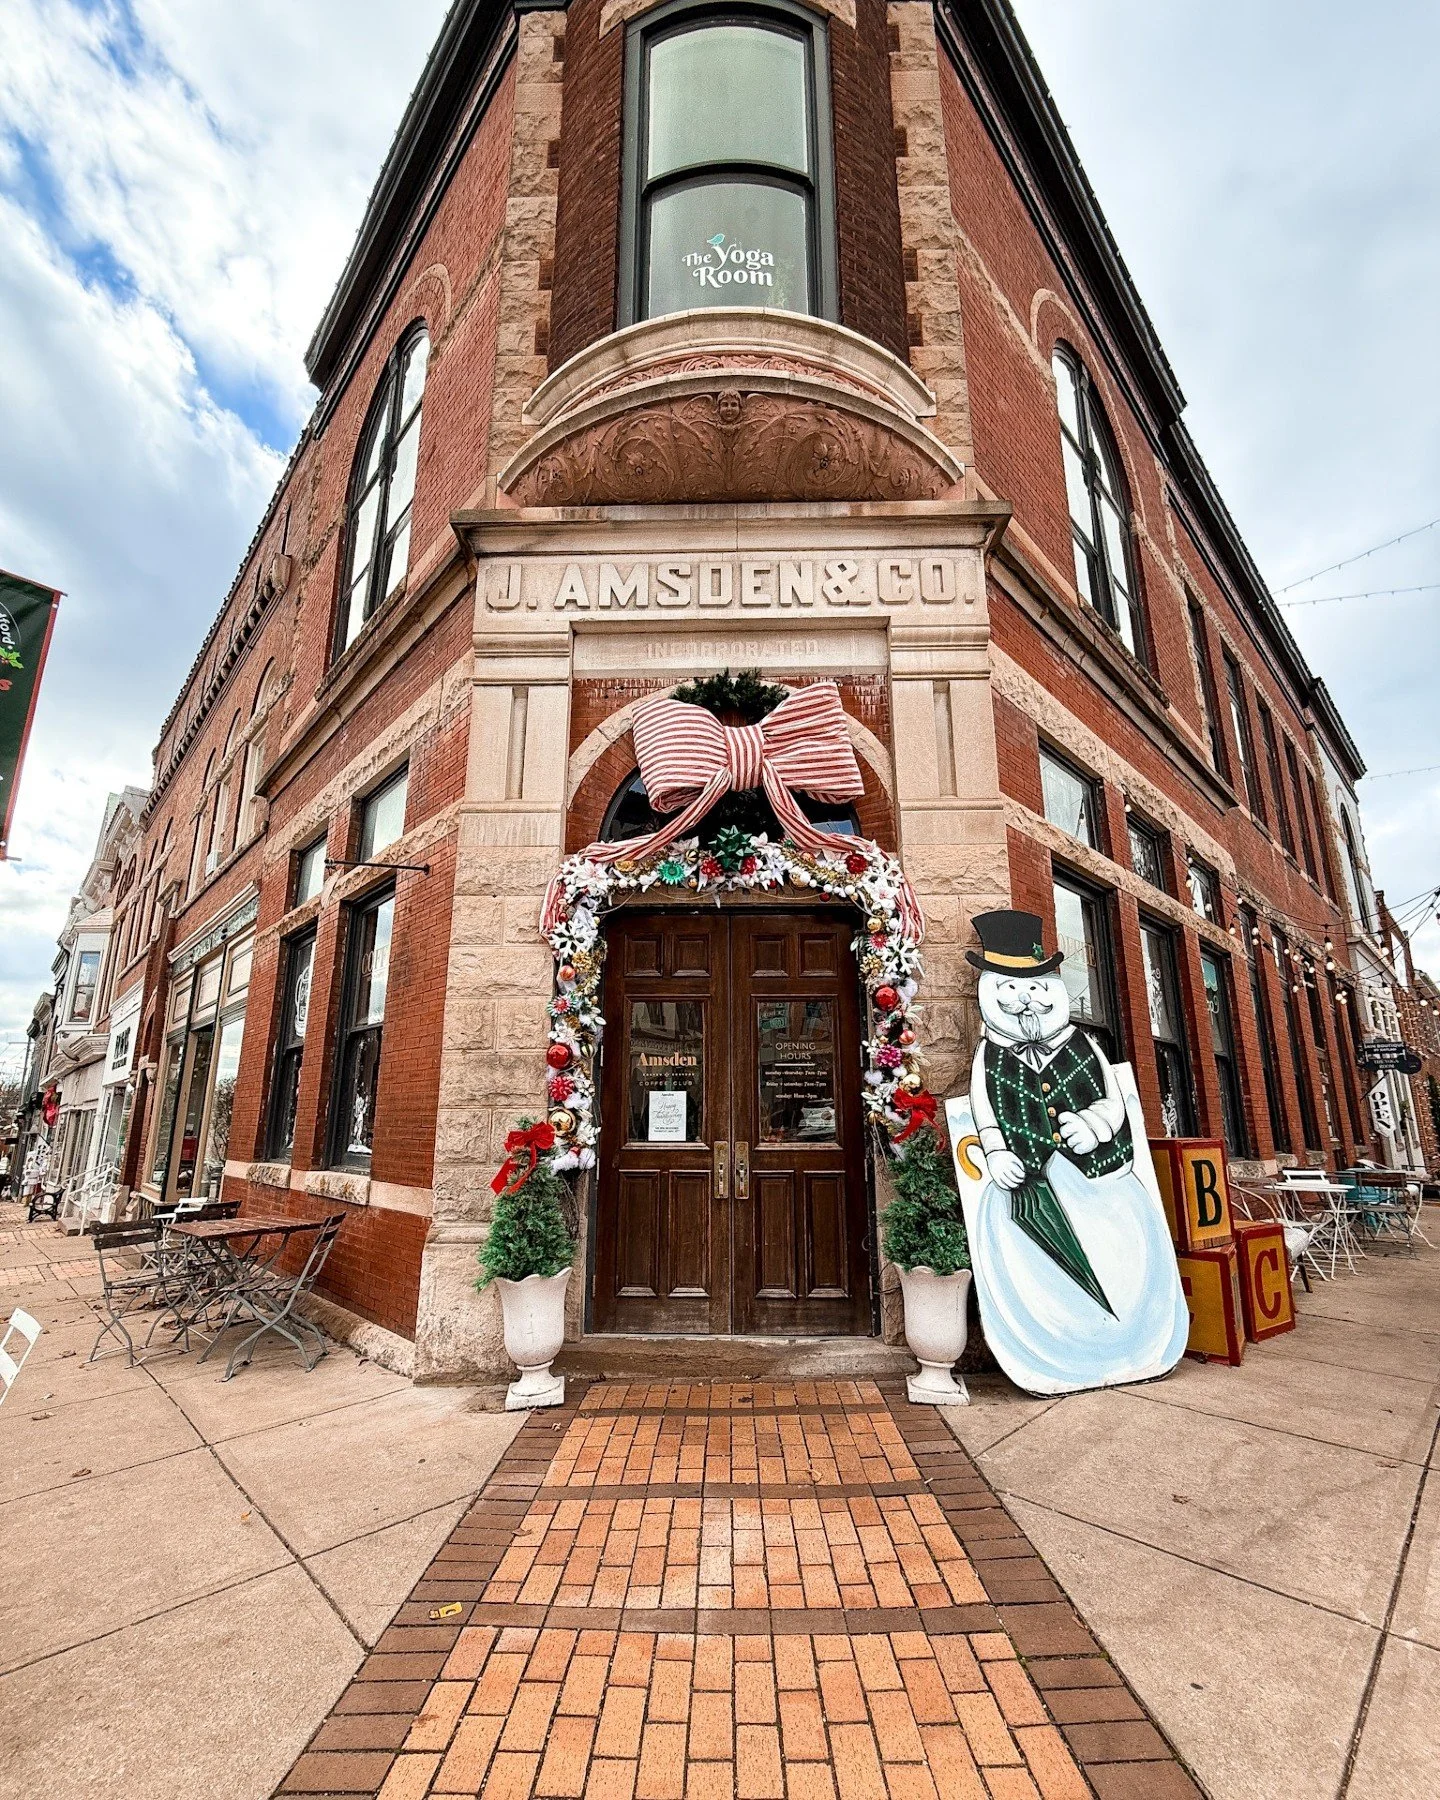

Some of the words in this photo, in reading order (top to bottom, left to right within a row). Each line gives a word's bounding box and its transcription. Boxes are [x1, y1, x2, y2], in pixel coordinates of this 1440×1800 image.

[682, 252, 712, 267] The
[711, 244, 774, 270] Yoga
[692, 266, 774, 288] Room
[485, 563, 538, 612] J.
[775, 1042, 816, 1050] OPENING
[780, 1052, 812, 1060] HOURS
[637, 1051, 698, 1066] Amsden
[1191, 1159, 1223, 1228] B
[1254, 1248, 1282, 1320] C
